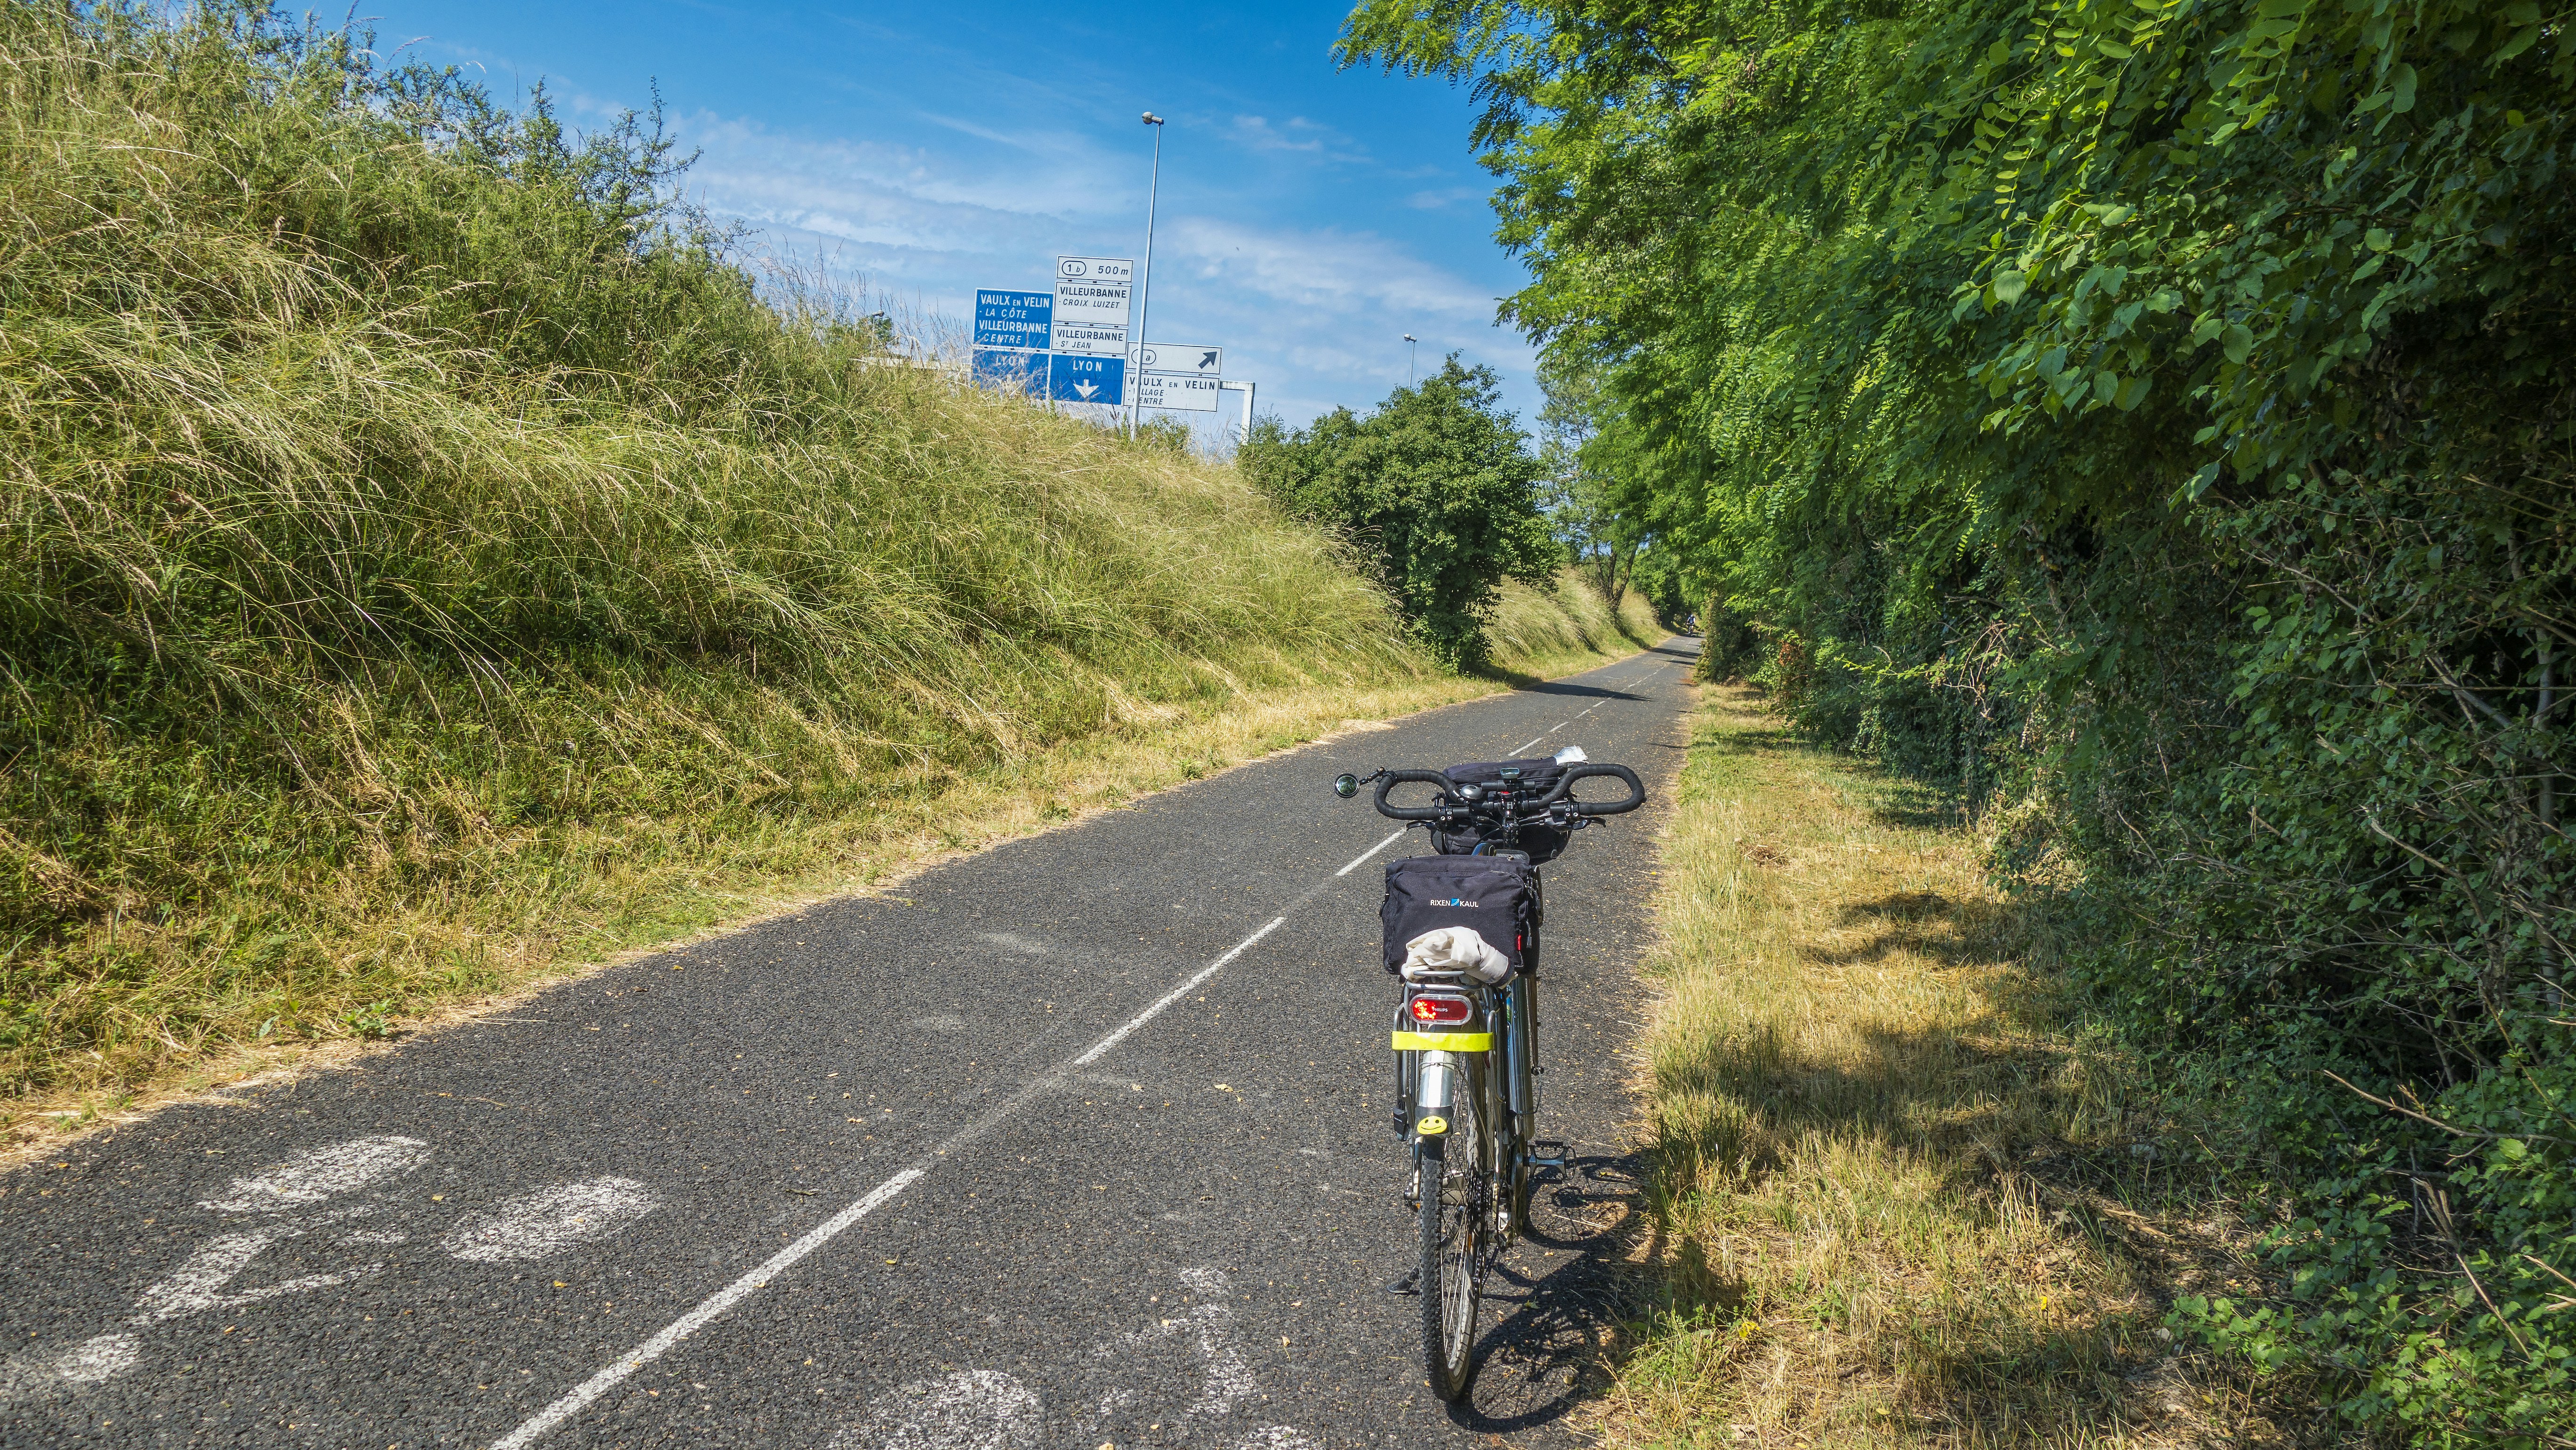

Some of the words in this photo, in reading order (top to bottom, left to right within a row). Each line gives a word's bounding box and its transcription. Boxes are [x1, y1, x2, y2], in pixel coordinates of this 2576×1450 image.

[1068, 264, 1071, 272] 1
[1098, 266, 1119, 274] 500
[1060, 286, 1127, 298] VILLEURBANNE
[980, 294, 1010, 306] VAULX
[1023, 296, 1050, 308] VELIN
[1063, 298, 1088, 306] CROIX
[1093, 300, 1120, 308] LUIZET
[985, 308, 995, 317] LA
[1001, 307, 1027, 319] CÔTE
[979, 320, 1047, 334] VILLEURBANNE
[984, 333, 1022, 344] CENTRE
[1057, 329, 1124, 341] VILLEURBANNE
[995, 355, 1025, 367] LYON
[1073, 360, 1102, 372] LYON
[1130, 377, 1162, 387] VULX
[1185, 380, 1215, 390] VELIN
[1133, 388, 1164, 396] LLAGE
[1132, 396, 1163, 405] ENTRE
